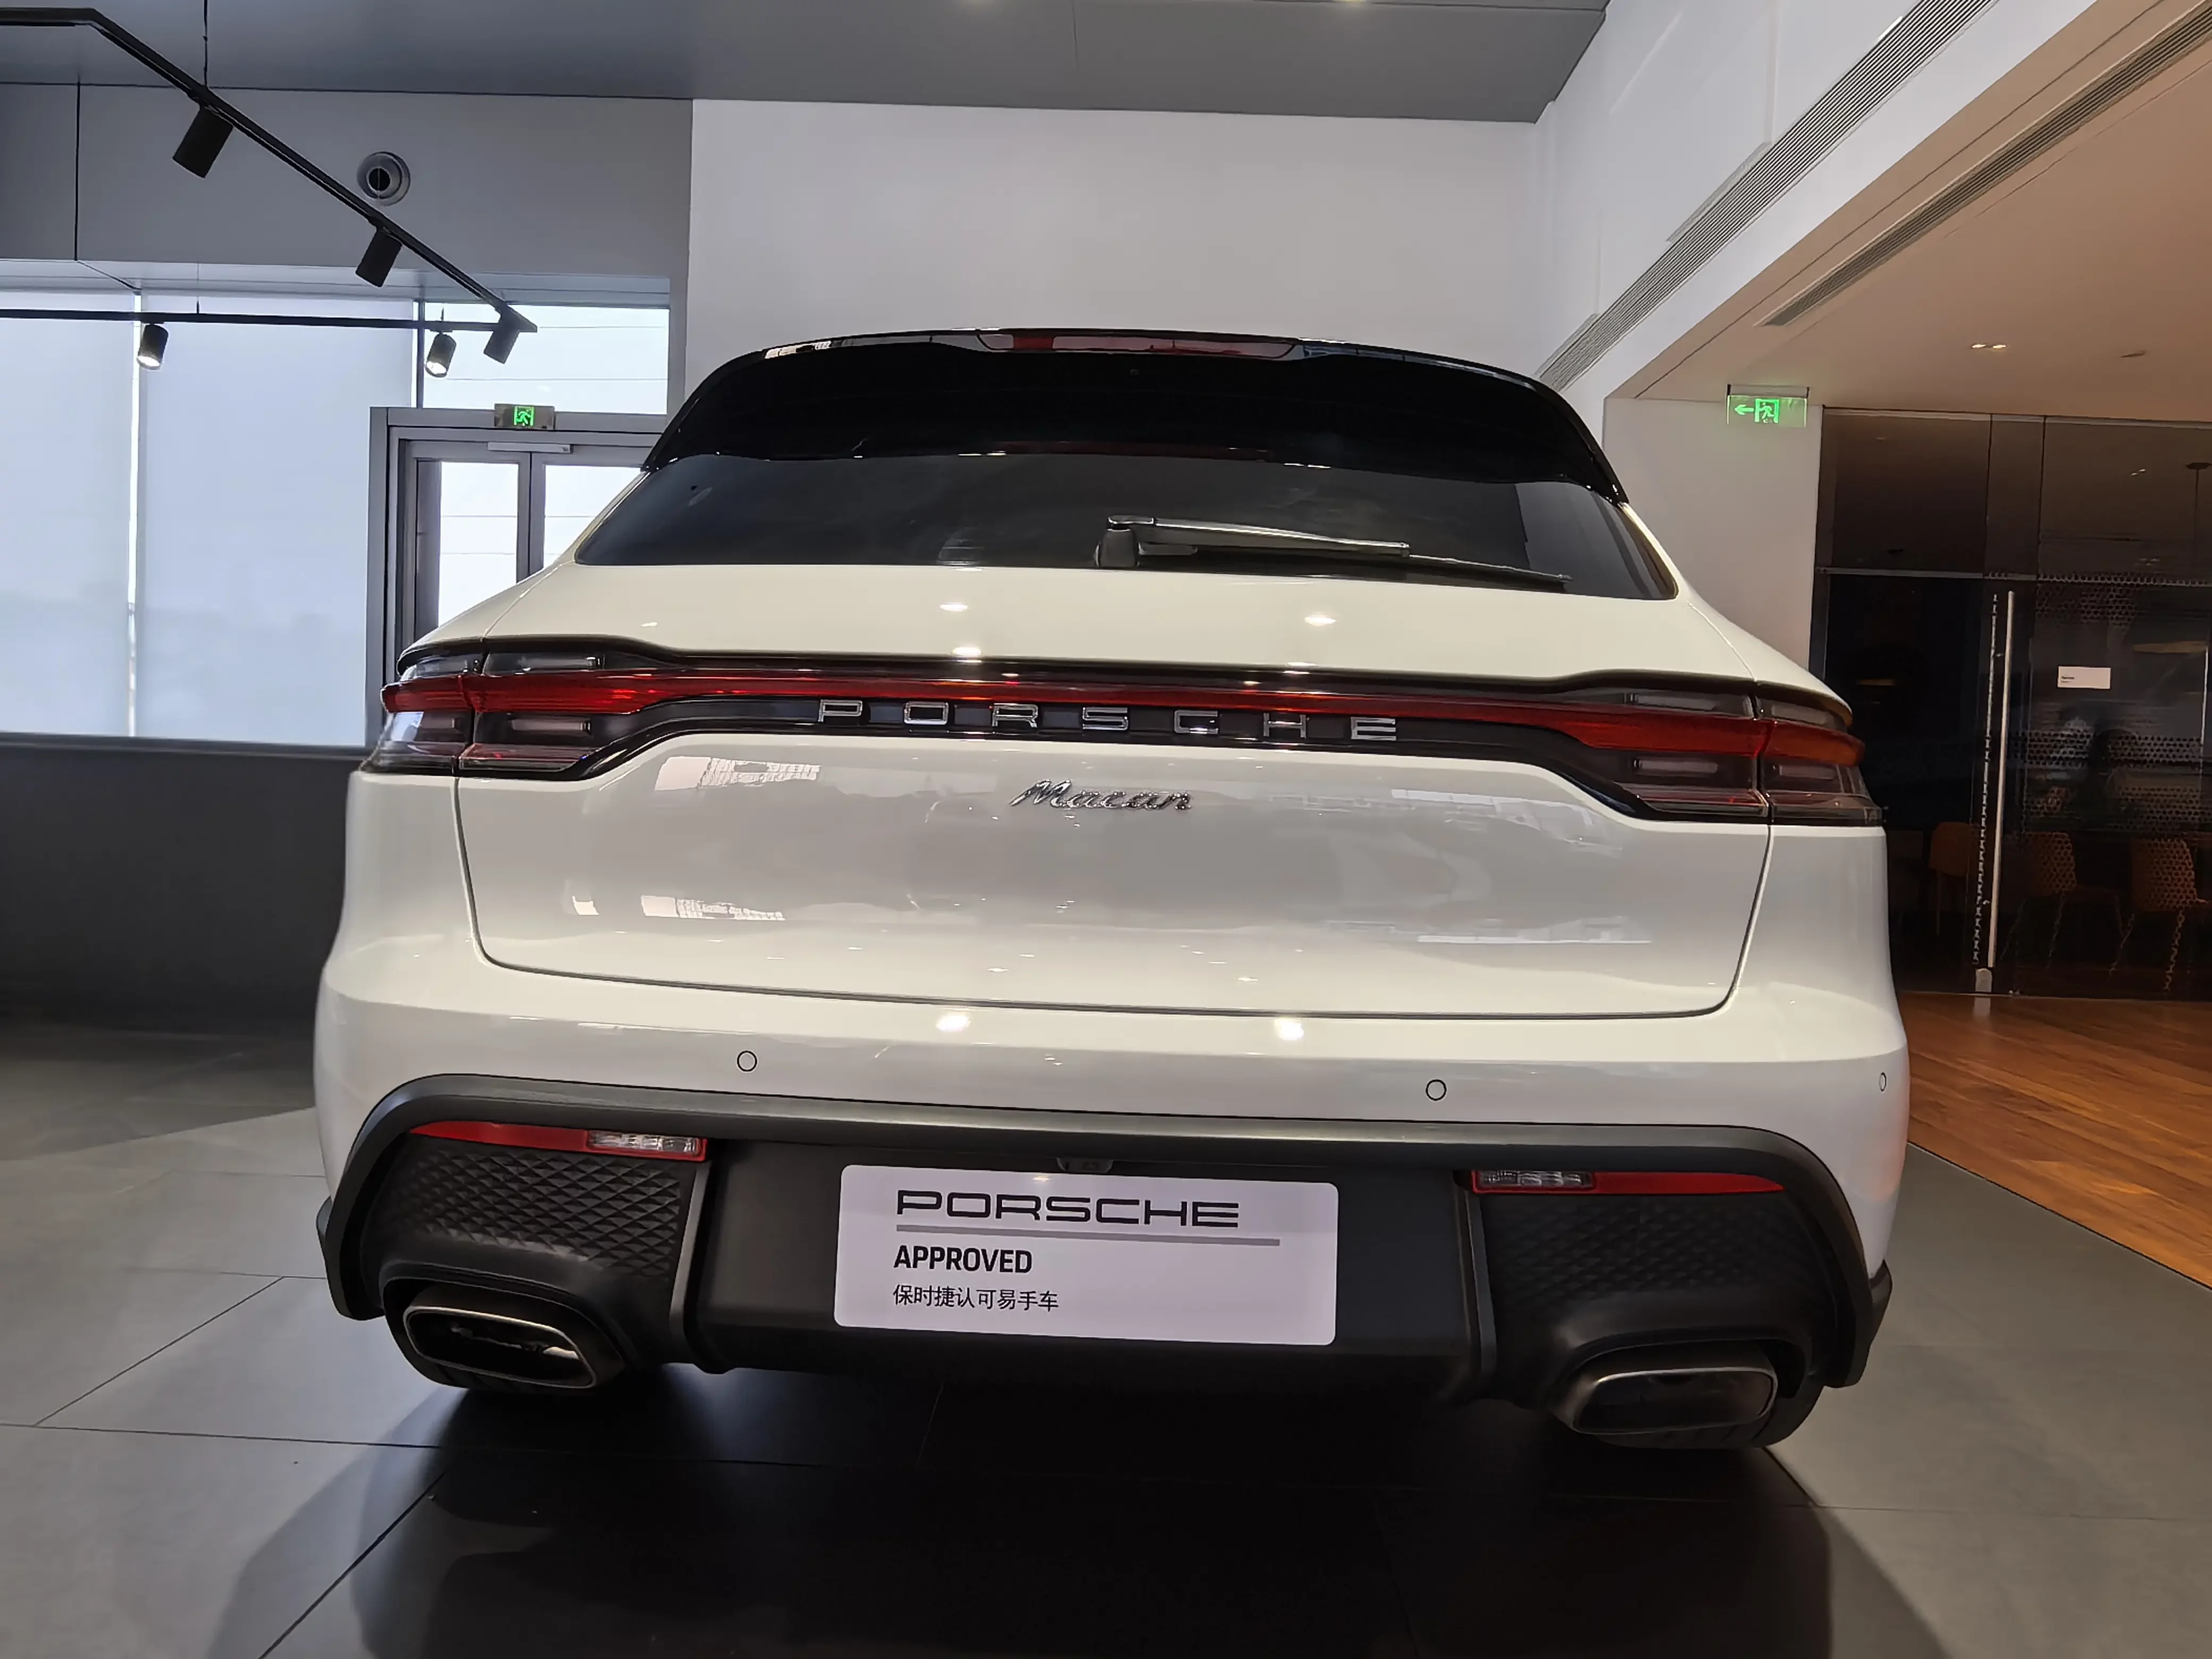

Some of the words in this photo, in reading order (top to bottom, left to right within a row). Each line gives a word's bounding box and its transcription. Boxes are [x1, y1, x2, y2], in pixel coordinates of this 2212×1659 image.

[818, 699, 1397, 741] PORSCHE
[1009, 778, 1192, 811] Macan
[896, 1189, 1239, 1228] PORSCHE
[893, 1244, 1032, 1274] APPROVED
[893, 1284, 1059, 1312] 保时捷认可易手车
